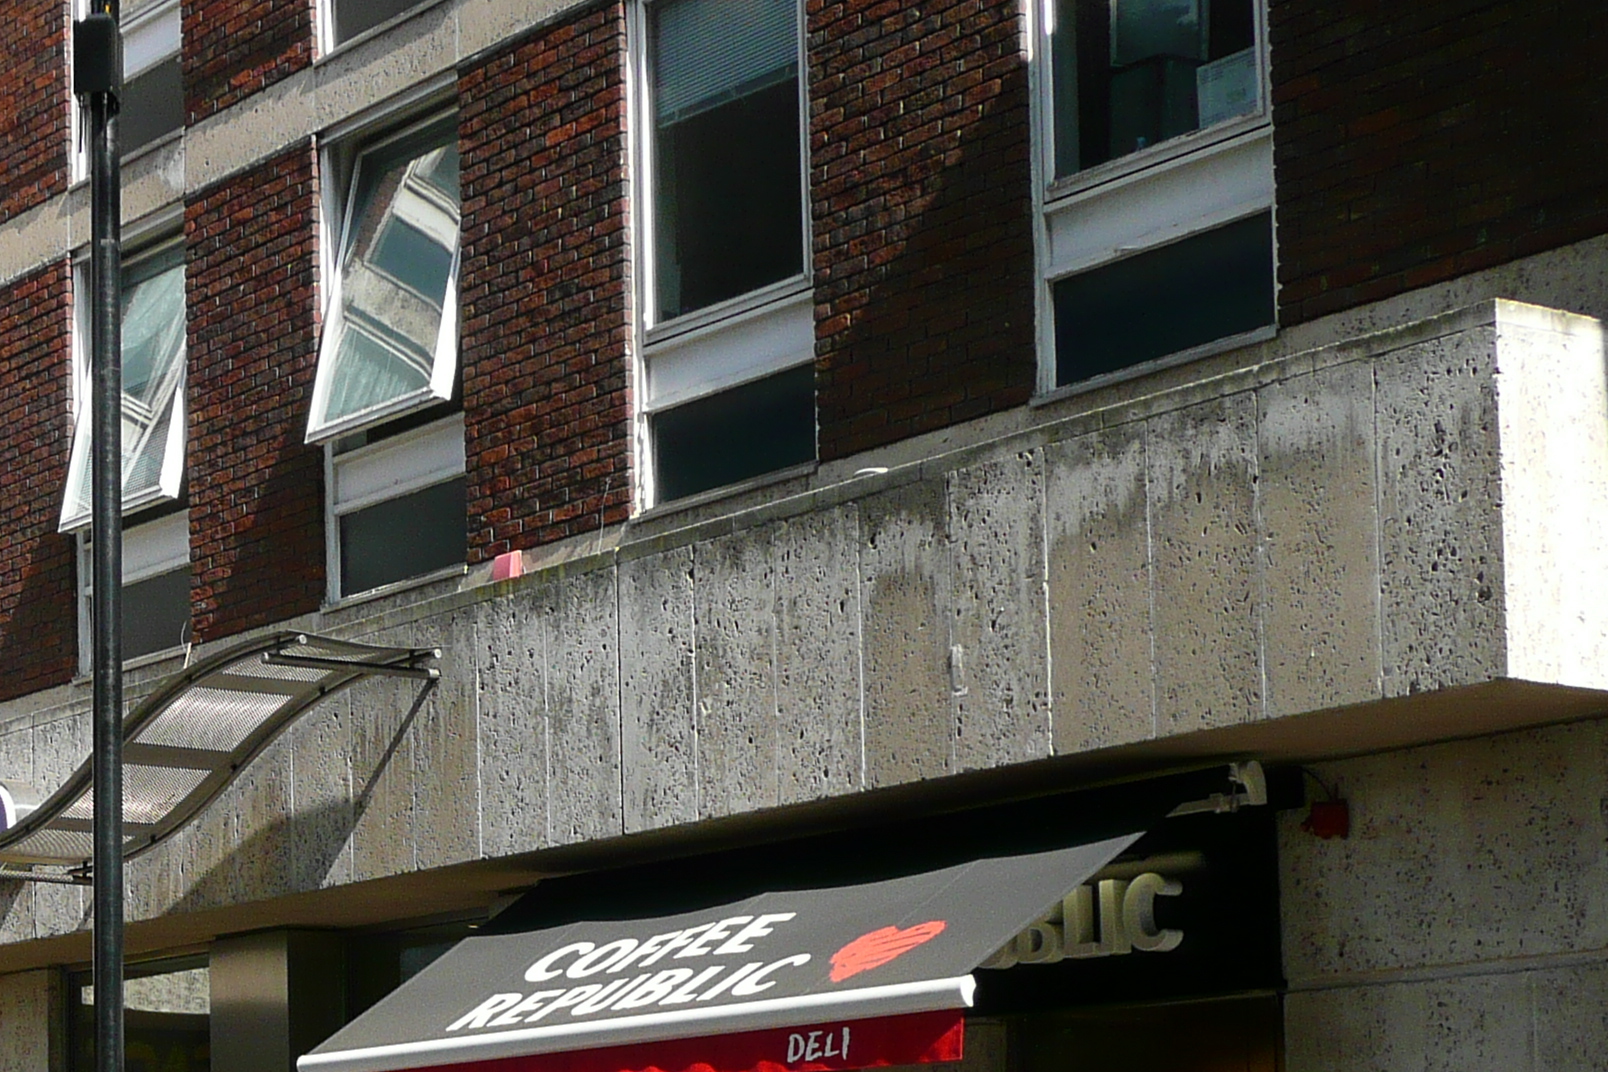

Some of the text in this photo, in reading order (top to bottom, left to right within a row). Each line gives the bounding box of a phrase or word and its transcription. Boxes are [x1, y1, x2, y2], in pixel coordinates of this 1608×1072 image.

[524, 911, 797, 983] COFFEE
[445, 953, 813, 1032] REPUBLIC
[786, 1026, 851, 1063] DELI
